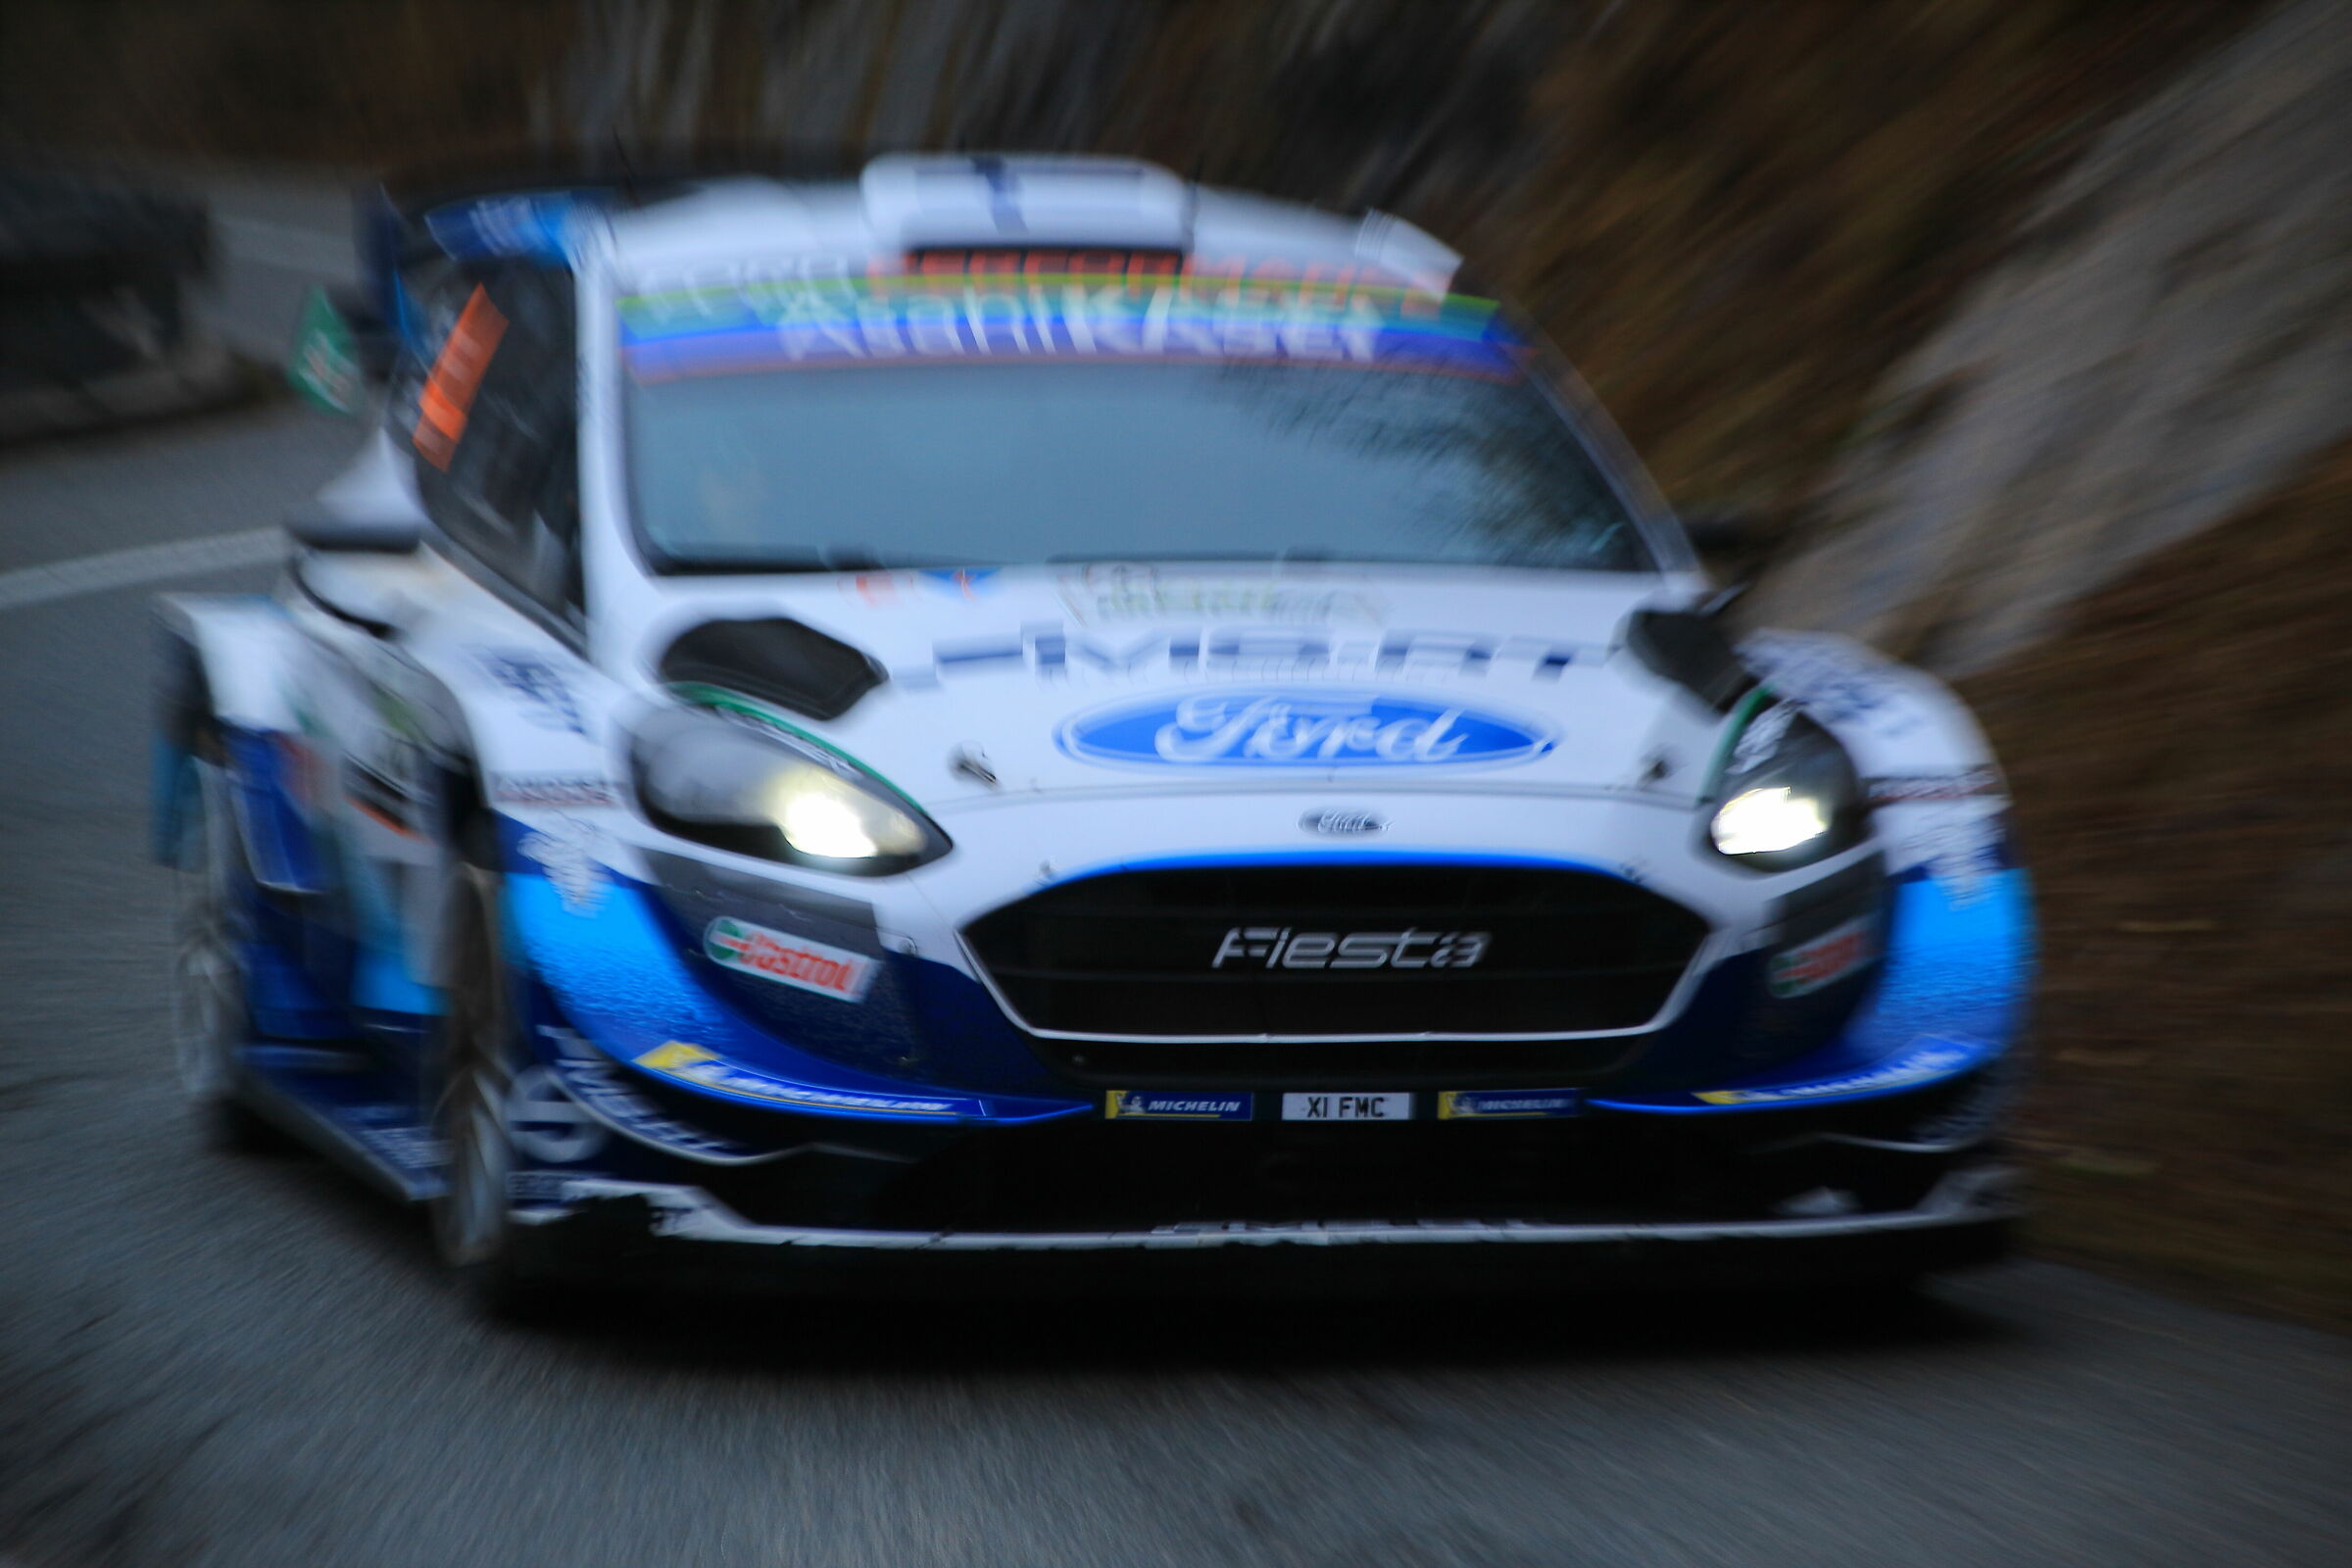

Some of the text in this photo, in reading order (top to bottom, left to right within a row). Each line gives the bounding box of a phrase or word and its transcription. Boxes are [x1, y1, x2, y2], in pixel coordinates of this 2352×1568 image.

[1154, 691, 1470, 763] Ford
[1211, 927, 1490, 968] Fiesta
[1148, 1100, 1241, 1112] MICHELIN
[1339, 1097, 1385, 1118] FMC
